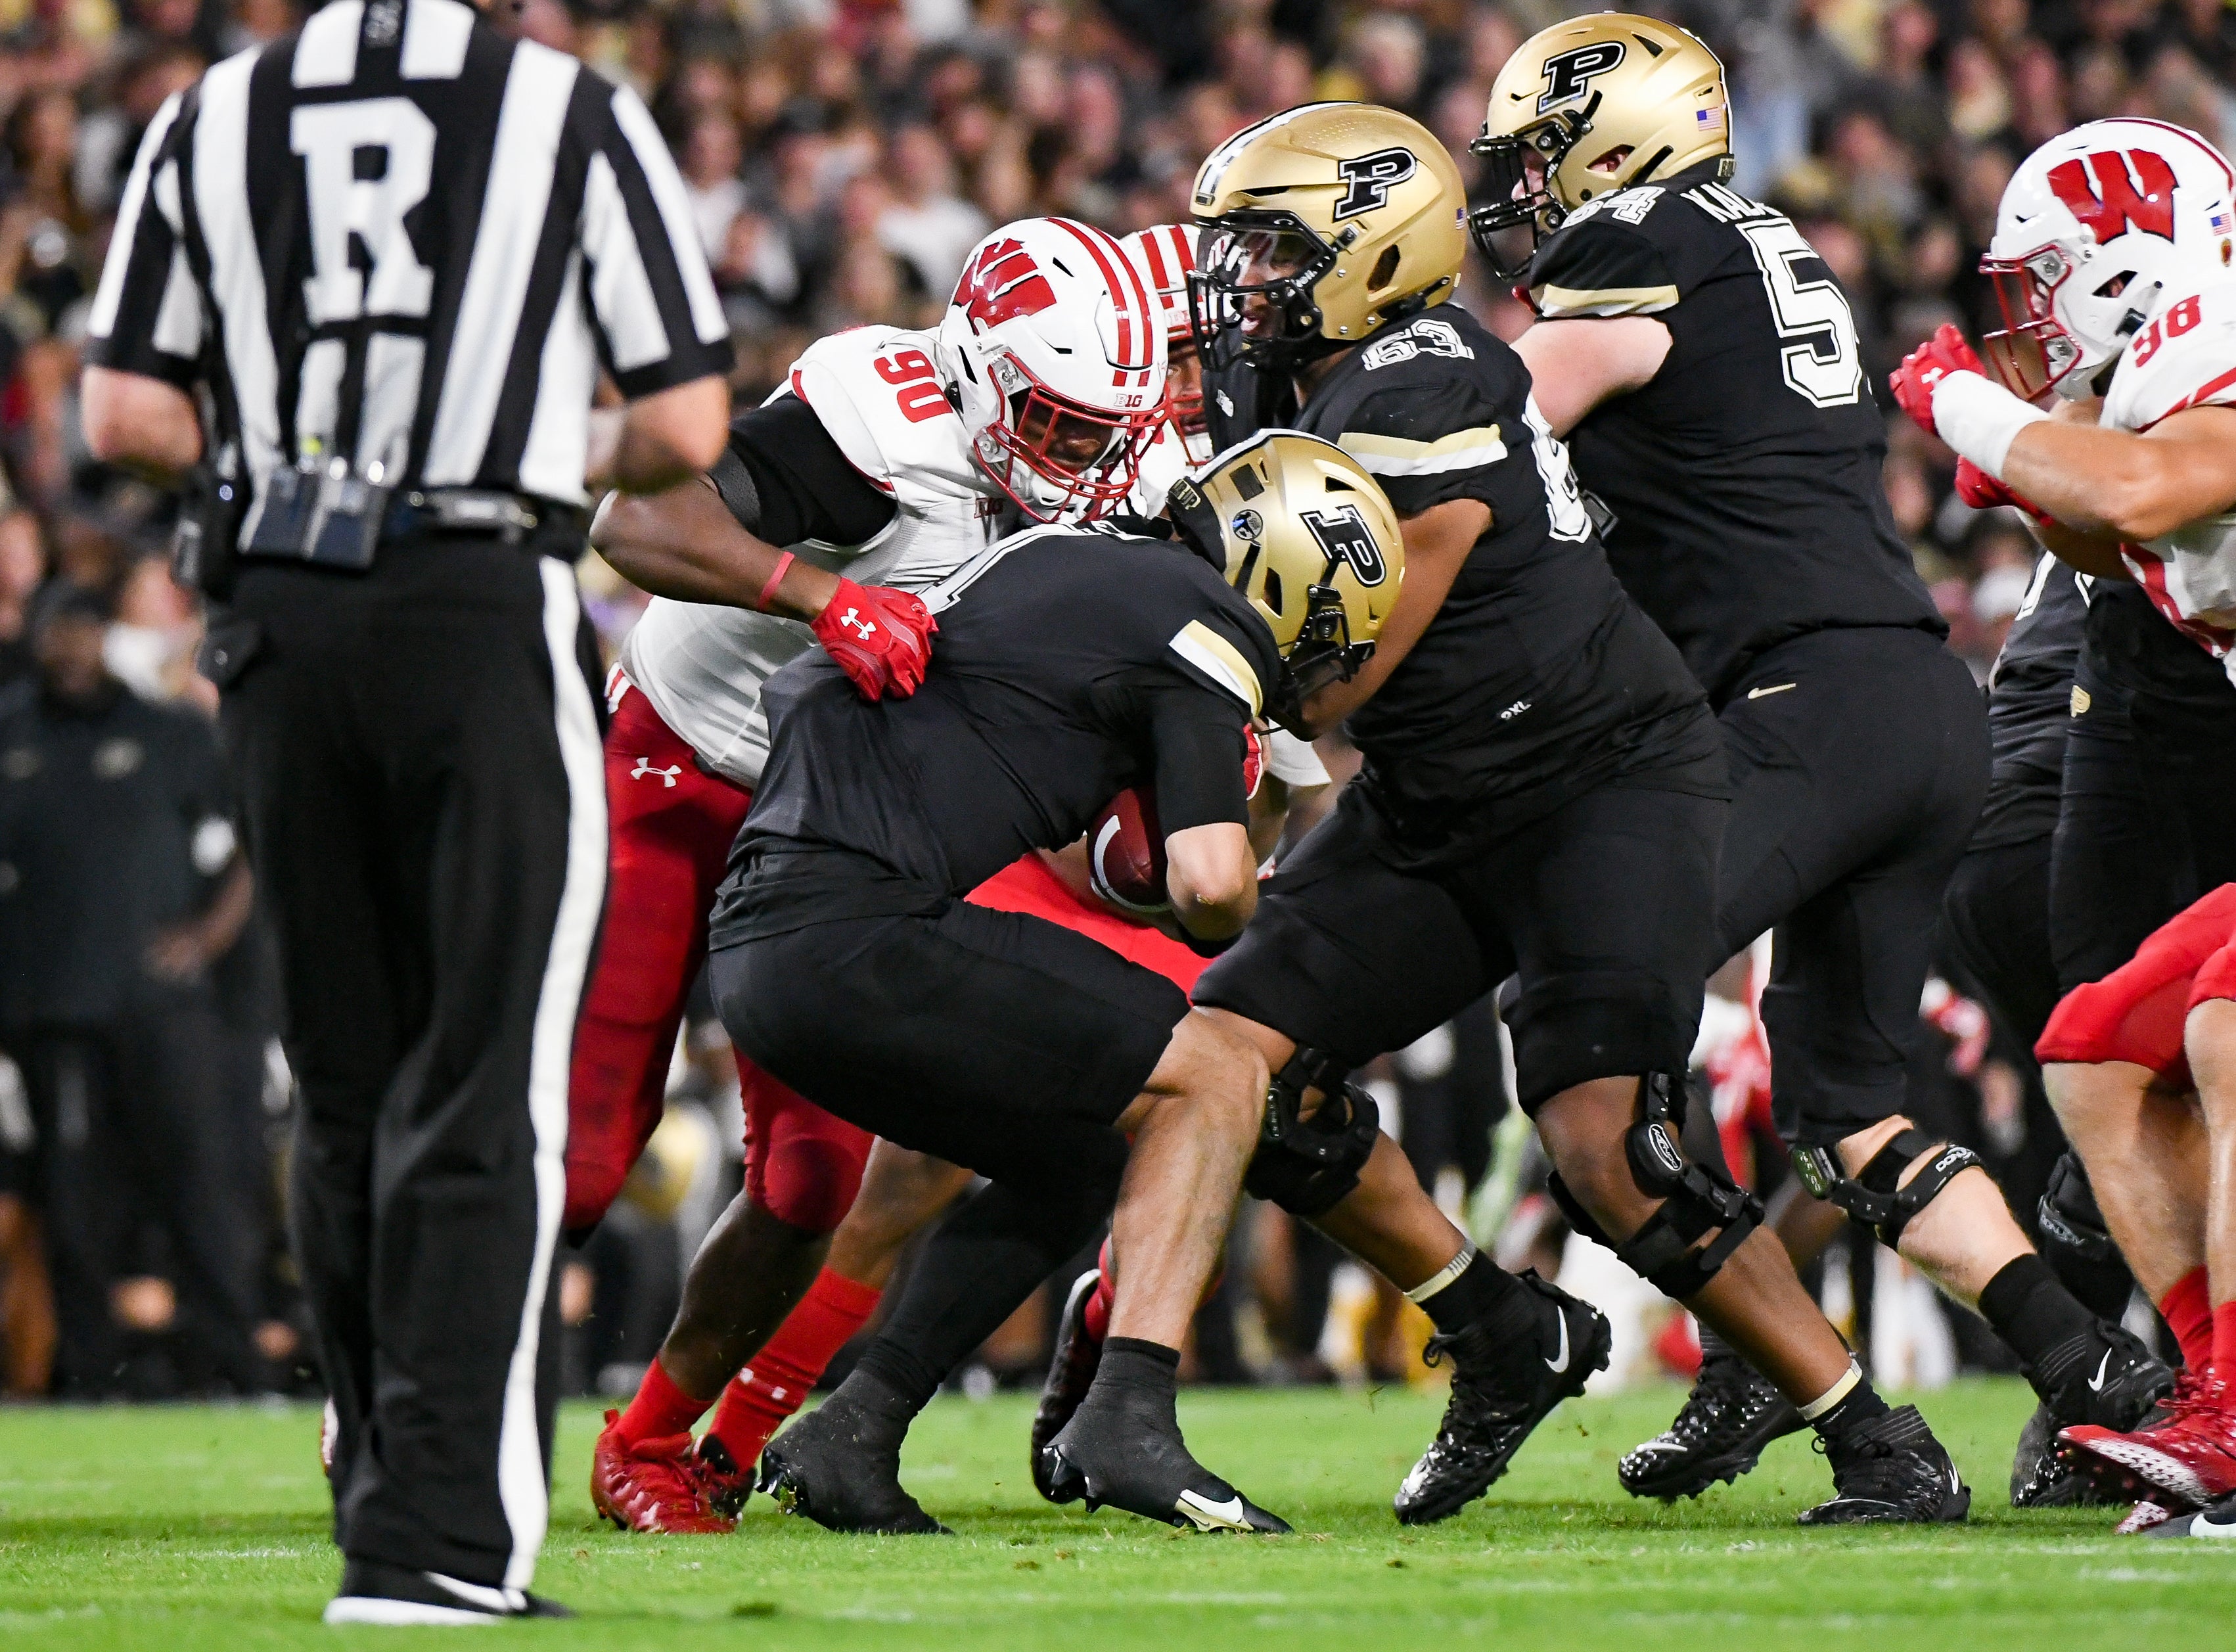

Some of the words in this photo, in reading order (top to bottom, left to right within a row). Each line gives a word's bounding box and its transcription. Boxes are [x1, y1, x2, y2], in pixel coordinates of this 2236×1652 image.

[1537, 40, 1626, 115] P
[291, 97, 436, 325] R
[1333, 146, 1417, 223] P
[2047, 148, 2178, 245] W
[953, 237, 1057, 335] W
[1361, 319, 1475, 371] 63
[2133, 295, 2201, 367] 98
[874, 350, 953, 423] 90
[1299, 504, 1386, 587] P
